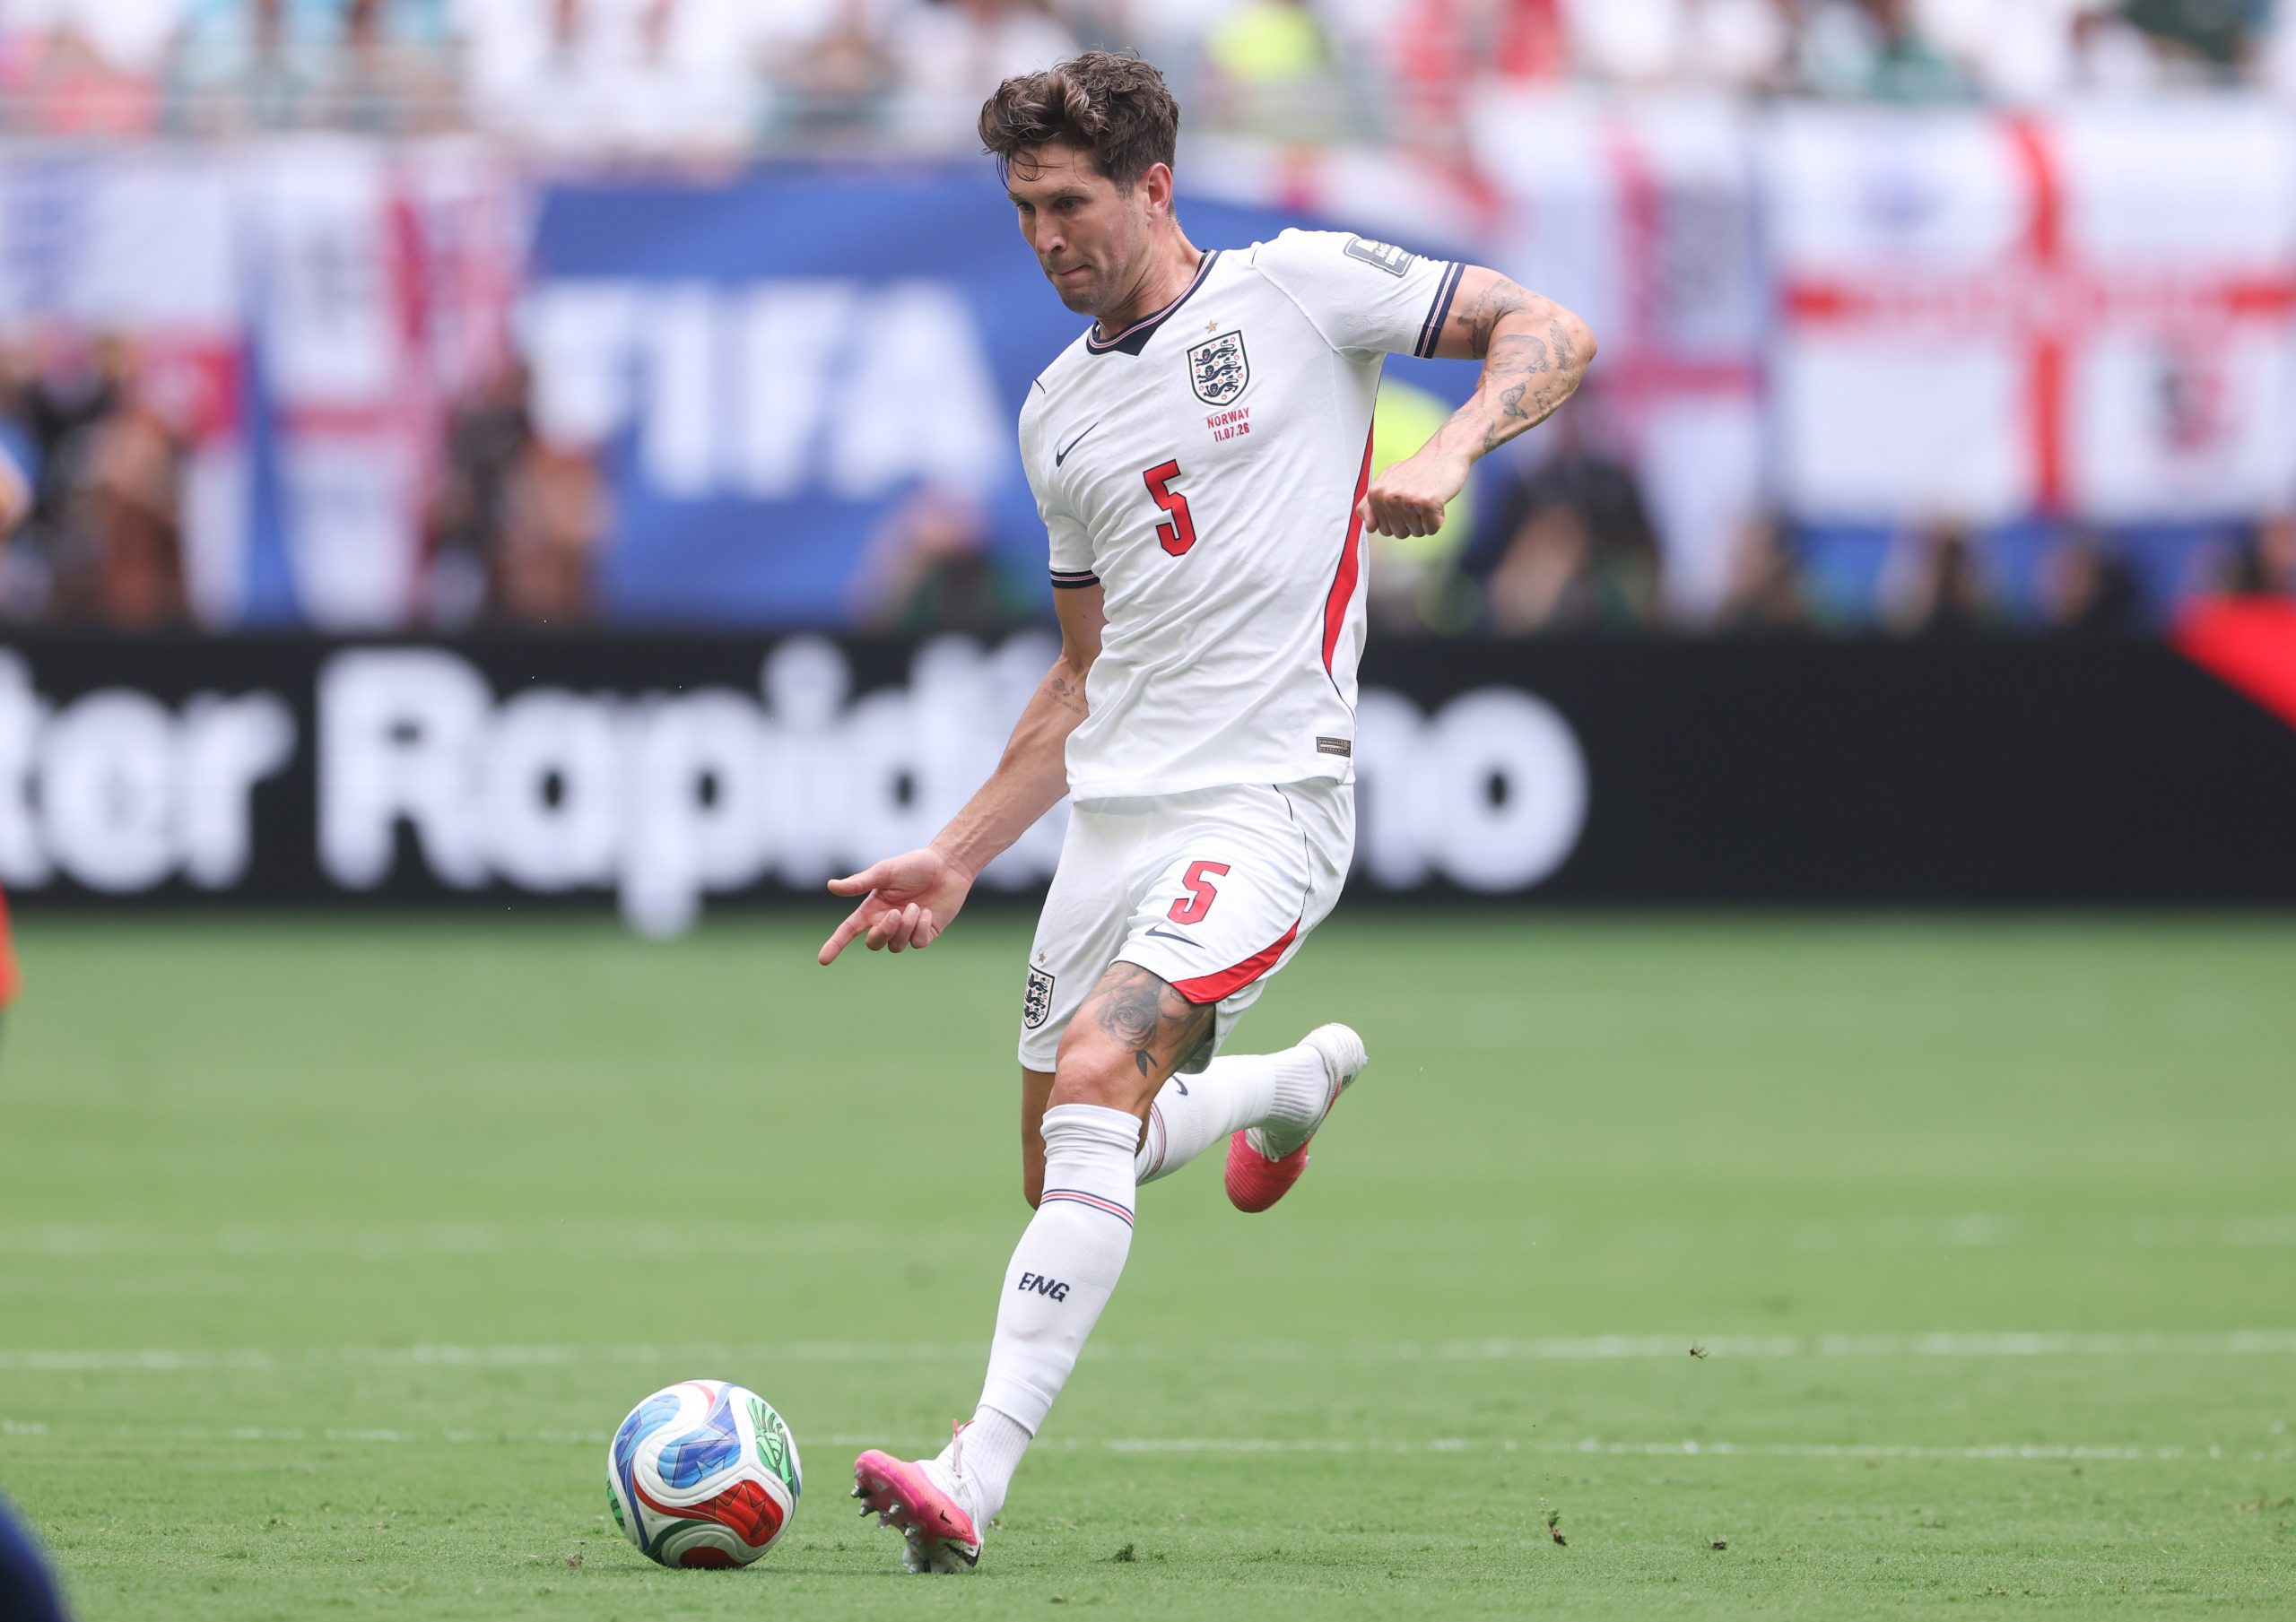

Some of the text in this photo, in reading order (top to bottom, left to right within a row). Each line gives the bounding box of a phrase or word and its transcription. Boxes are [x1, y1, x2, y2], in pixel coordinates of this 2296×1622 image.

[527, 282, 1012, 500] FIFA
[1207, 407, 1249, 429] NORWAY
[1213, 422, 1250, 442] 11.07.26
[1143, 459, 1197, 557] 5
[1167, 860, 1231, 925] 5
[1018, 1271, 1070, 1303] ENG
